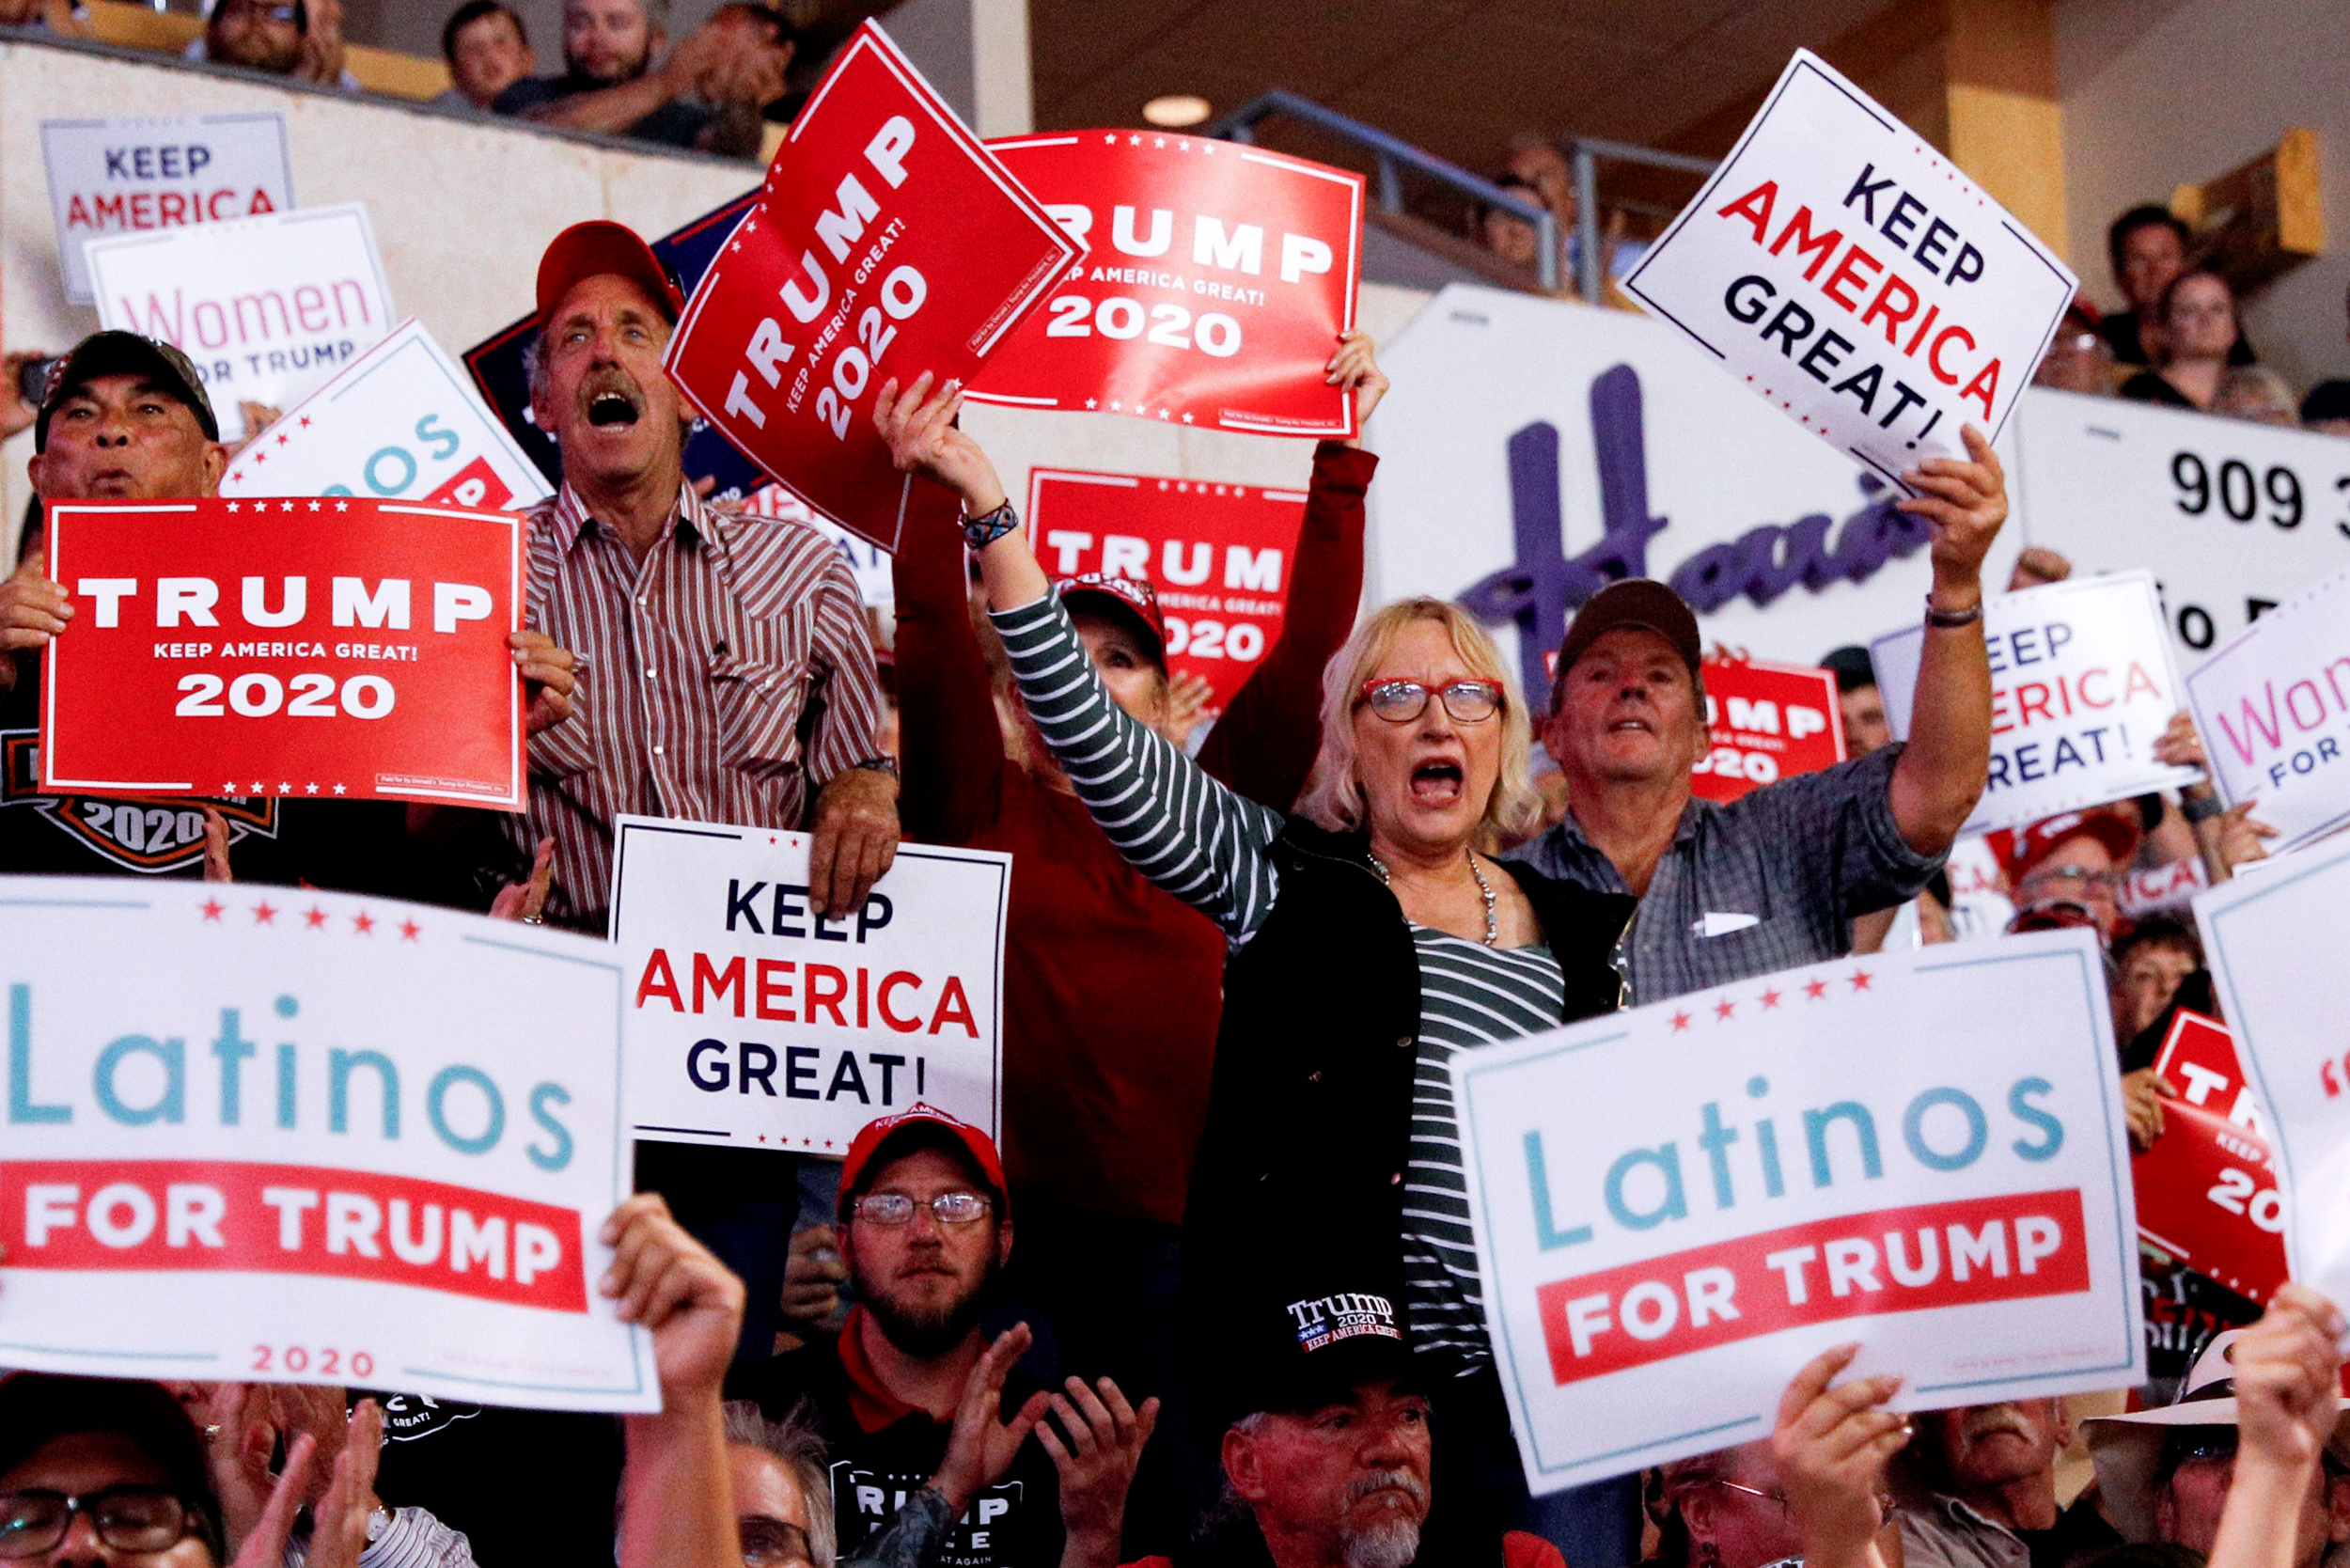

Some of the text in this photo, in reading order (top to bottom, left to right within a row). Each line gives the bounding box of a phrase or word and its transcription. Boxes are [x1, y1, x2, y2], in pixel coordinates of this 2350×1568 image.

[105, 146, 212, 180] KEEP
[68, 188, 274, 230] AMERICA
[1842, 163, 1984, 286] KEEP
[725, 116, 916, 430] TRUMP
[1042, 203, 1333, 284] RUMP
[122, 279, 369, 352] Women
[787, 217, 906, 414] KEEP AMERICA GREAT!
[1090, 267, 1185, 291] AMERICA
[1193, 279, 1265, 307] GREAT!
[1716, 180, 2001, 423] AMERICA
[816, 265, 927, 442] 2020
[1046, 295, 1242, 358] 2020
[196, 340, 354, 384] OR TRUMP
[1724, 274, 1943, 449] GREAT!
[2171, 450, 2304, 529] 909
[1047, 529, 1282, 592] TRUM
[78, 575, 493, 633] TRUMP
[154, 642, 417, 662] KEEP AMERICA GREAT!
[1165, 617, 1264, 662] 020
[1986, 622, 2071, 673] EEP
[175, 673, 396, 719] 2020
[1992, 662, 2161, 734] ERICA
[1987, 723, 2132, 792] REAT!
[2268, 736, 2341, 788] FOR
[84, 802, 205, 854] 2020
[635, 948, 980, 1039] AMERICA
[8, 983, 575, 1172] Latinos
[686, 1038, 925, 1106] GREAT!
[1523, 1074, 2065, 1252] Latinos
[2206, 1167, 2282, 1233] 20
[24, 1183, 561, 1286] FOR TRUMP
[1286, 1293, 1394, 1330] Trump
[1565, 1215, 2062, 1358] FOR TRUMP
[1305, 1335, 1332, 1352] KEEP
[1331, 1324, 1376, 1342] AMERICA
[1337, 1313, 1377, 1328] 2020
[251, 1344, 375, 1379] 2020
[392, 1412, 431, 1428] GREAT!
